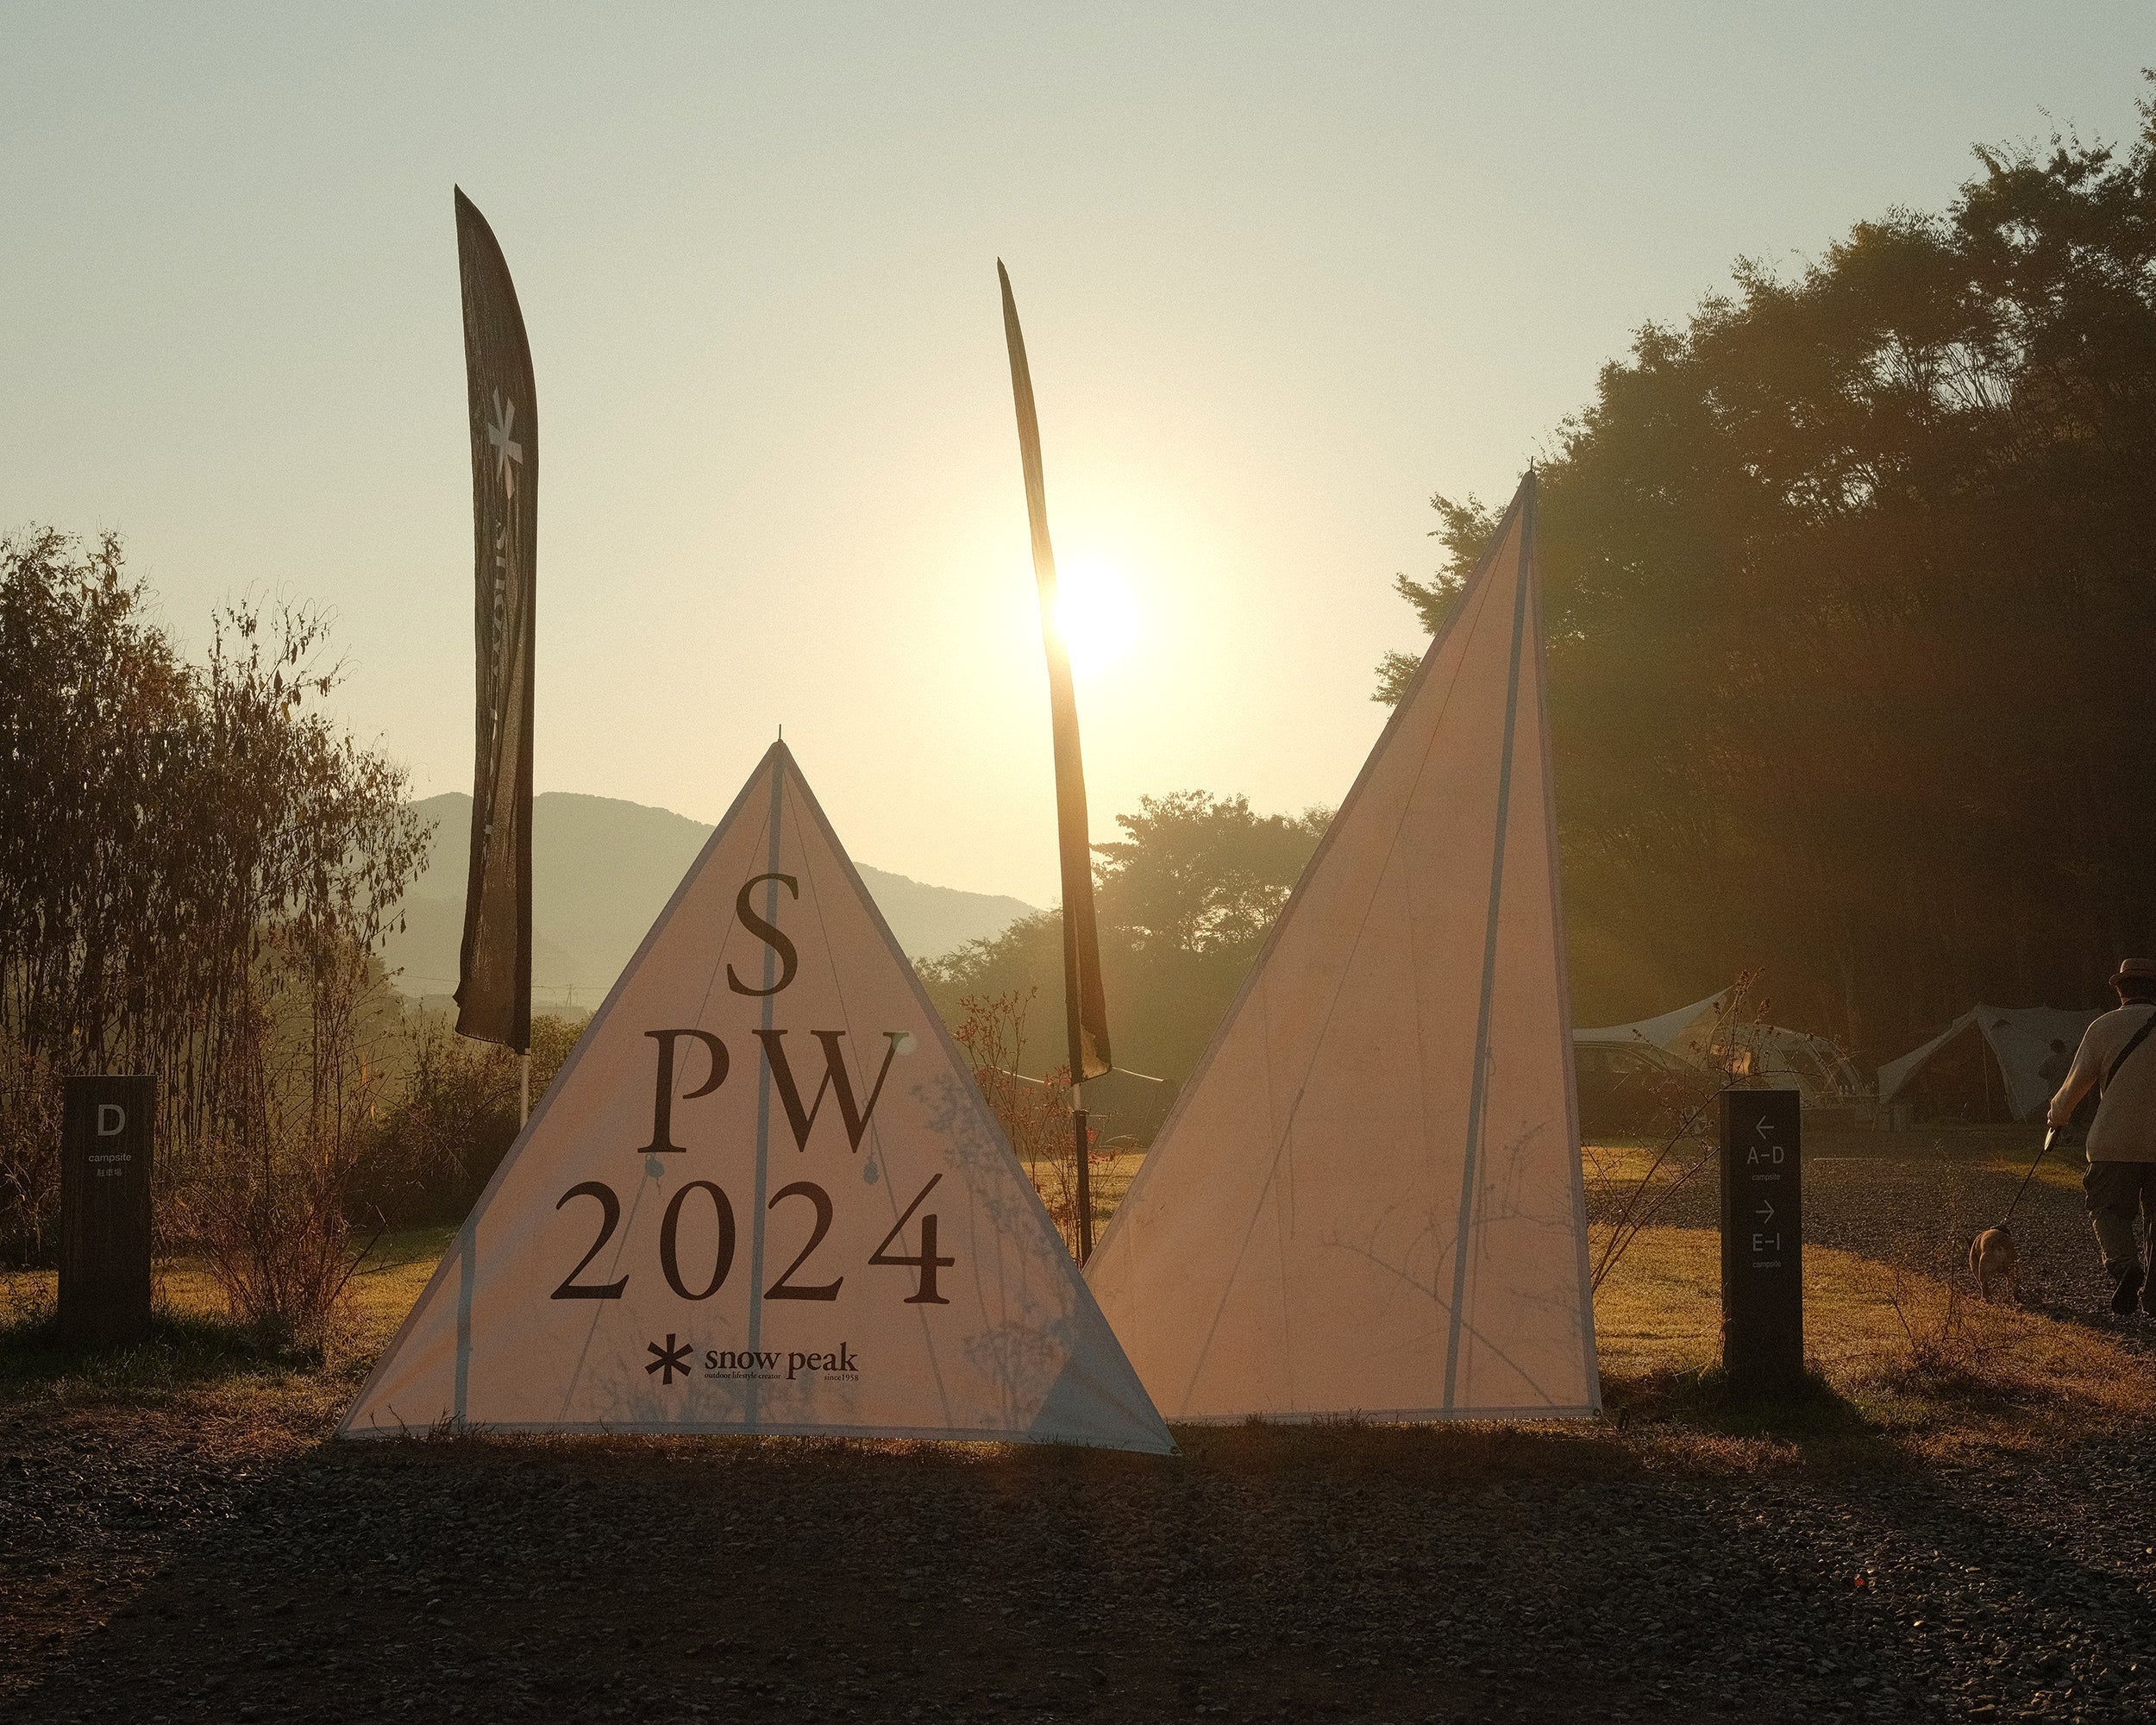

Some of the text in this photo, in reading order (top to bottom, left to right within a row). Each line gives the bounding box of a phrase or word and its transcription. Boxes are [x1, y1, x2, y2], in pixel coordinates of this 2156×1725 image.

[725, 872, 800, 998] S
[636, 1029, 911, 1155] PW
[97, 1104, 126, 1136] D
[88, 1152, 132, 1164] campsite
[1746, 1145, 1784, 1164] A-D
[1752, 1172, 1781, 1182] campsite
[550, 1173, 956, 1305] 2024
[1752, 1259, 1782, 1269] campsite
[705, 1341, 859, 1380] snow peak
[732, 1371, 757, 1381] lifestyle
